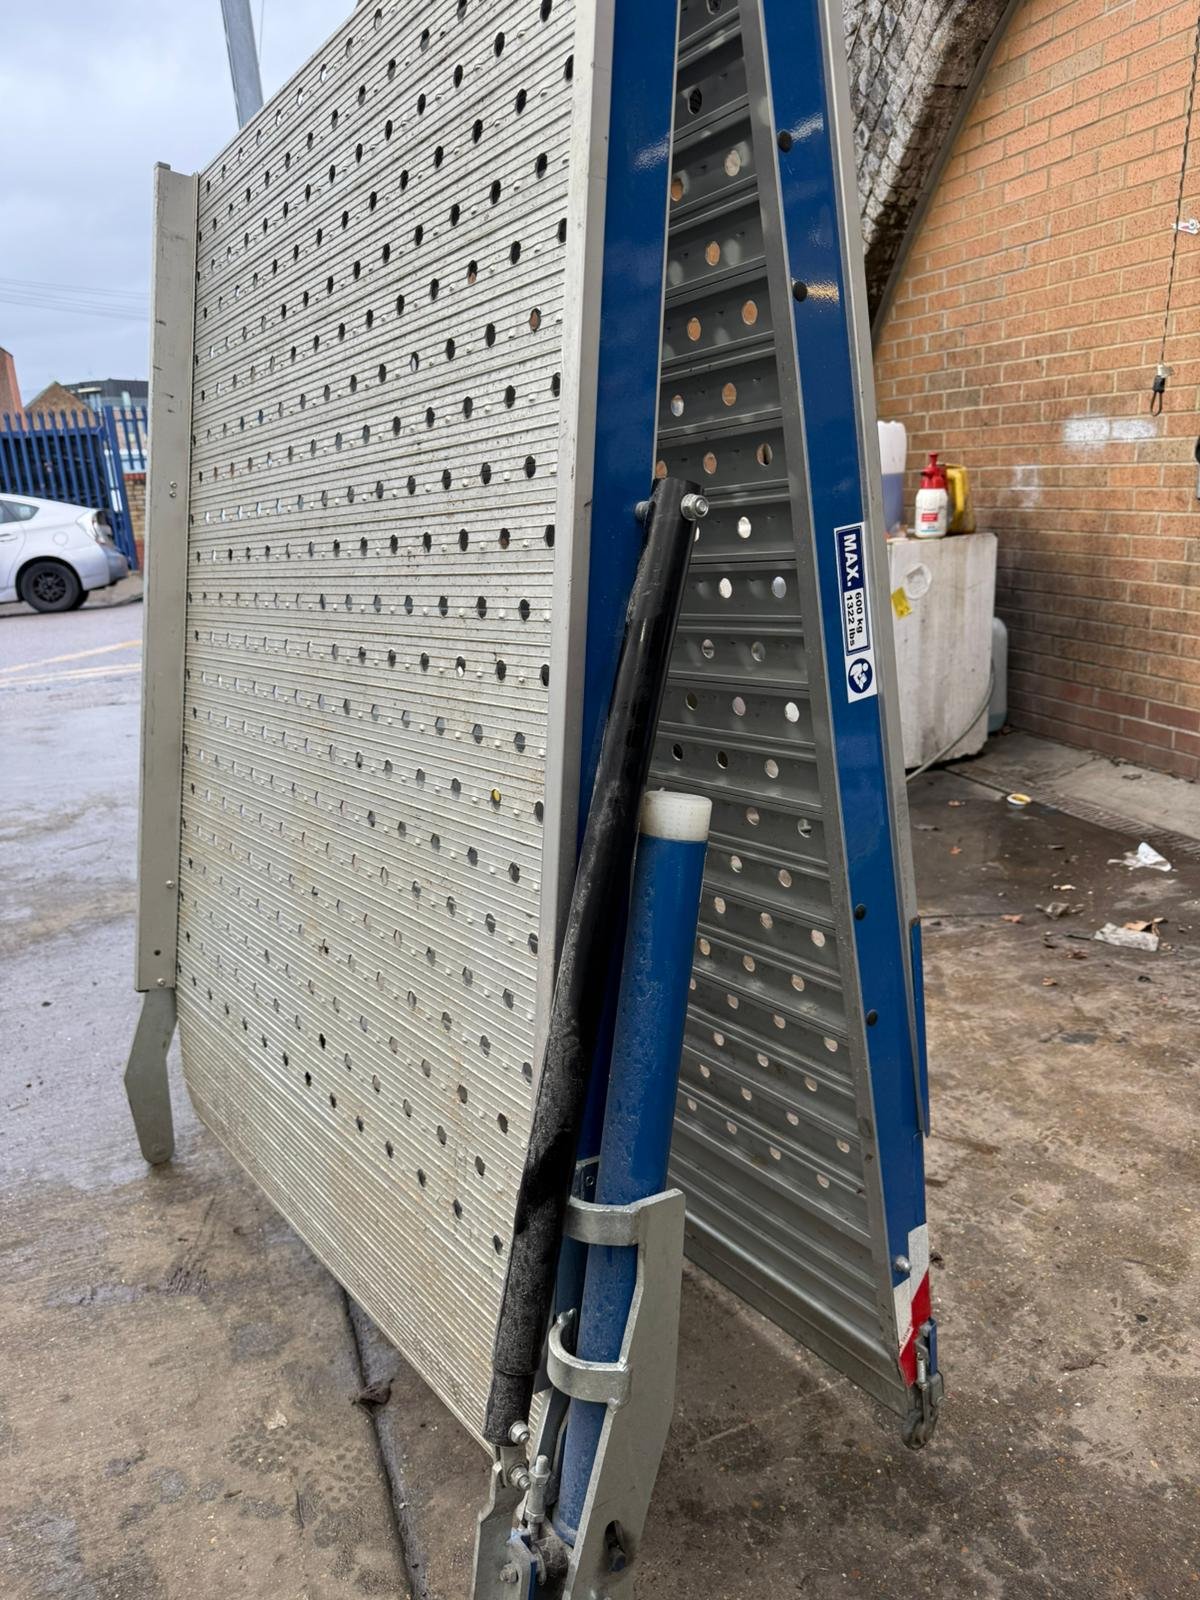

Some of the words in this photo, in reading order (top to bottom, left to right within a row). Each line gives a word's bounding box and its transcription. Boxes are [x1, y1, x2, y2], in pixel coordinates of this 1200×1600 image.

[843, 533, 860, 587] MAX.
[846, 594, 855, 625] 1322
[855, 591, 863, 615] 600
[848, 628, 856, 647] lbs
[856, 618, 864, 634] kg
